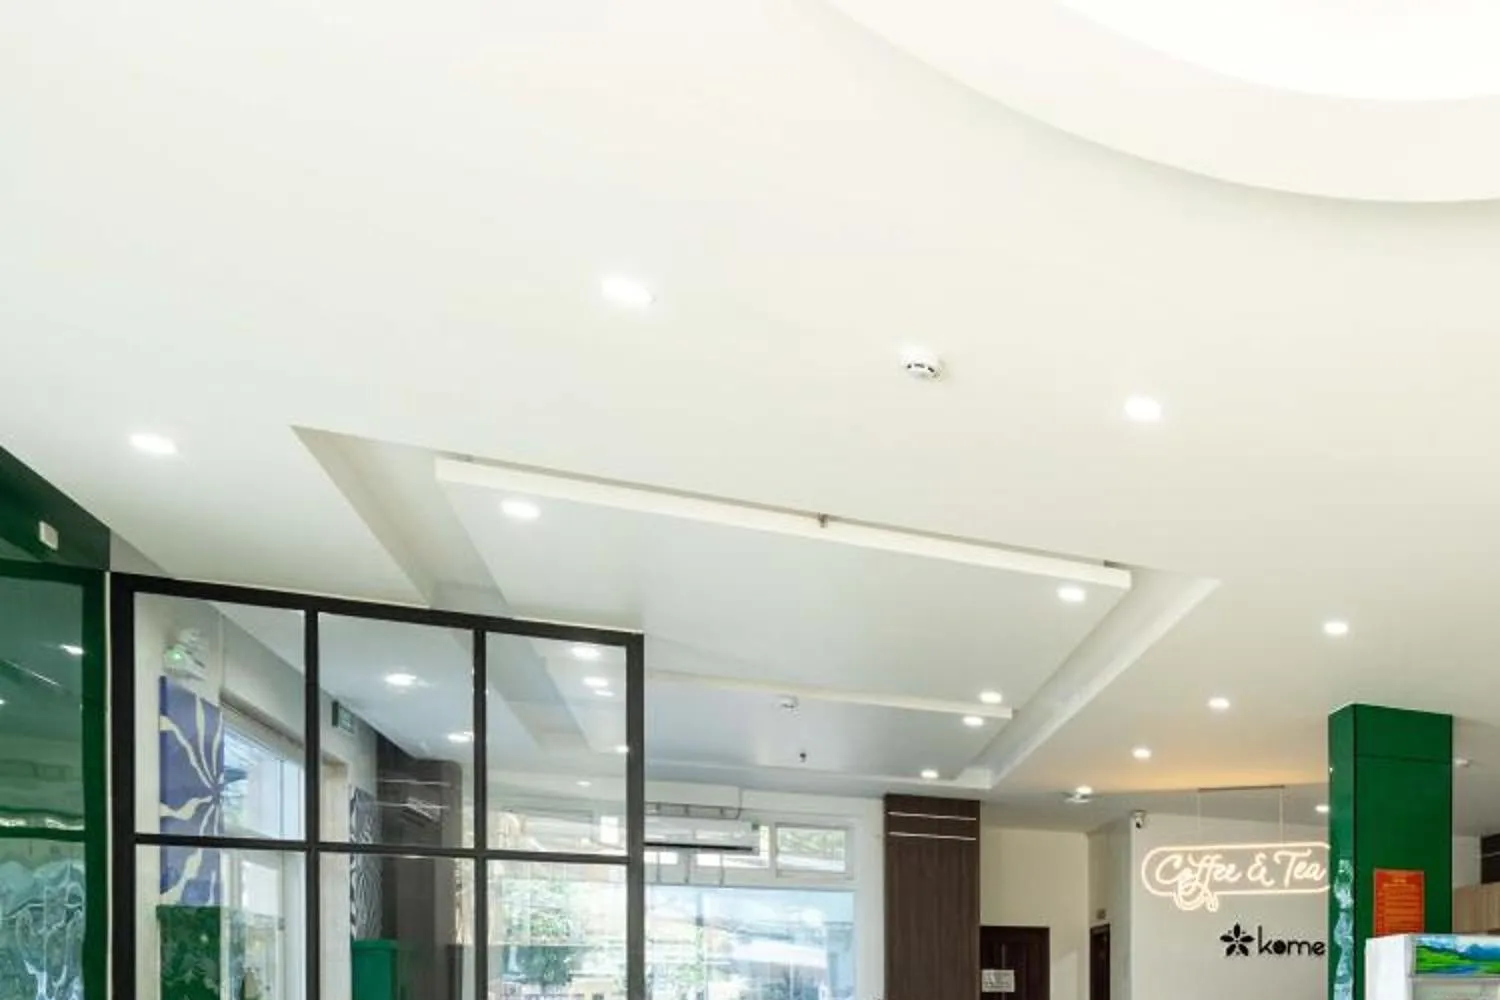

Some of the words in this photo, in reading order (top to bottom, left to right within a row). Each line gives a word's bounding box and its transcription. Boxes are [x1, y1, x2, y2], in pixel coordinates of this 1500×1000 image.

[1155, 852, 1243, 890] Coffee
[1247, 853, 1275, 887] &
[1274, 849, 1326, 888] Tea
[1257, 925, 1326, 956] kome
